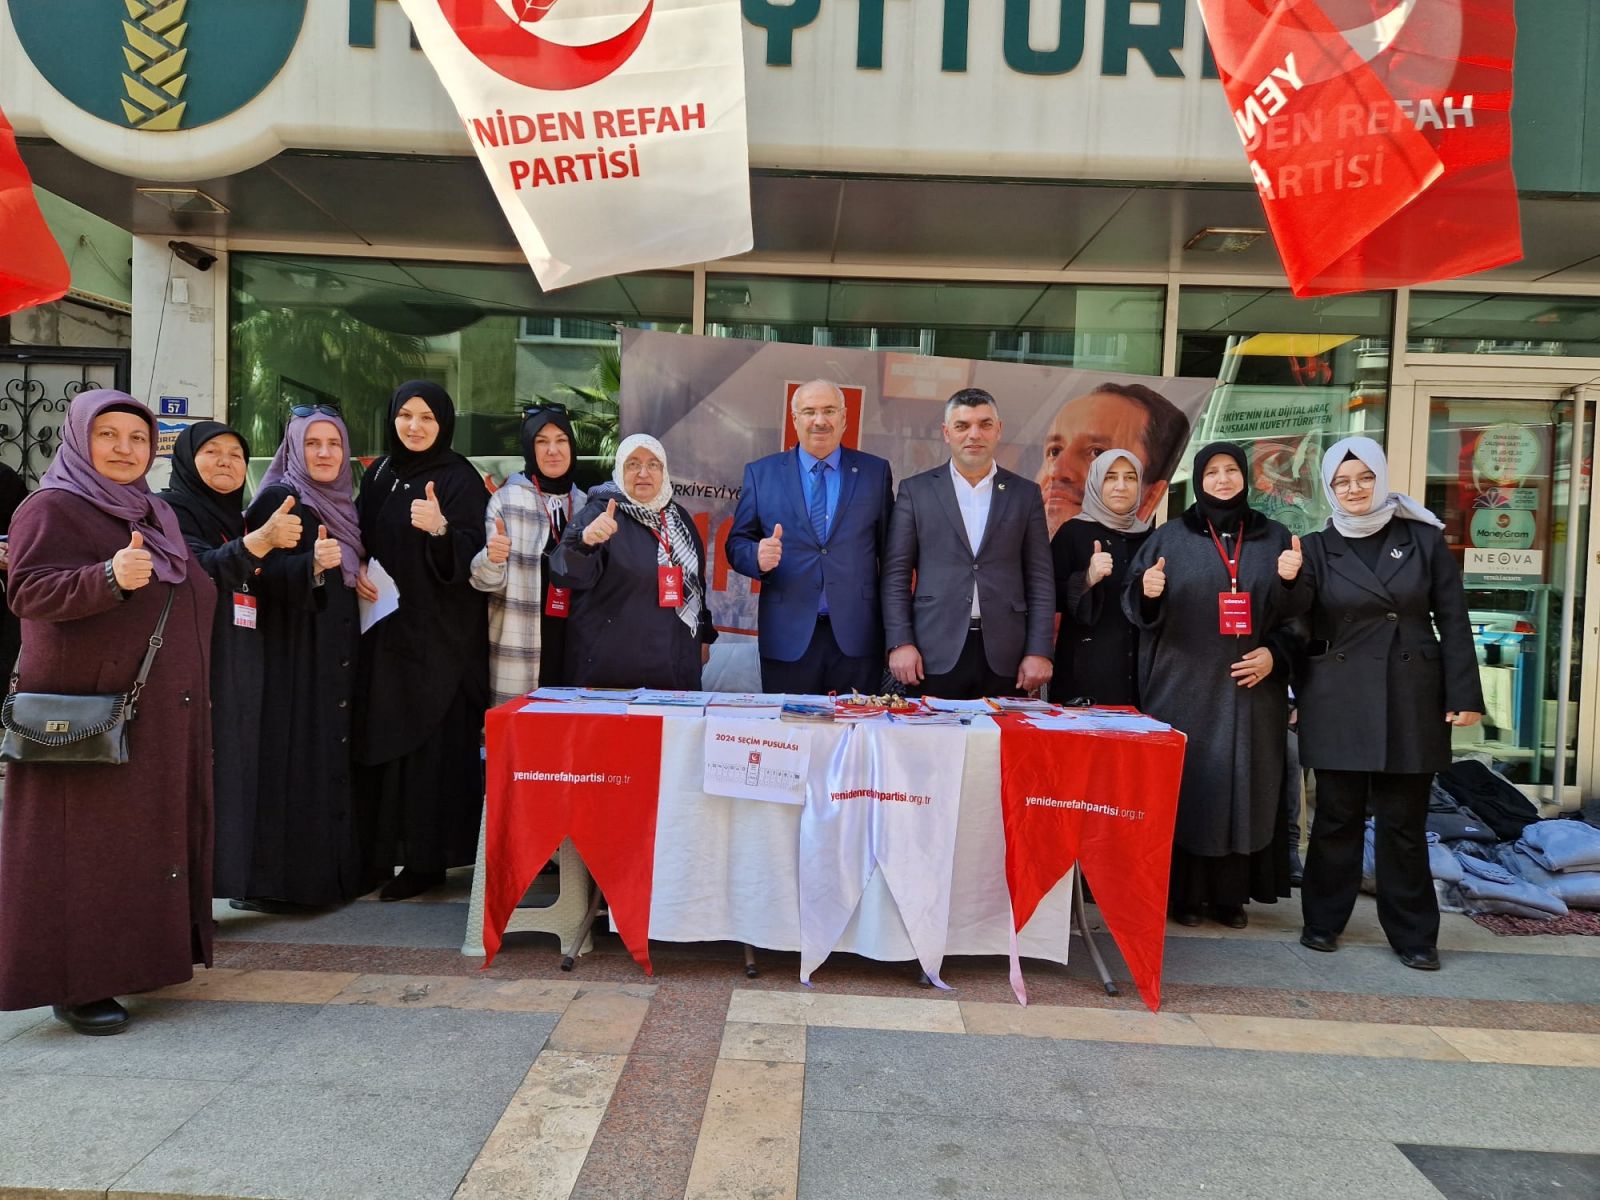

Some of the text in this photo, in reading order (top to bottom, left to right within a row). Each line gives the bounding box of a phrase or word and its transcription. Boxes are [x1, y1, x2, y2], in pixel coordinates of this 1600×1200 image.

[1338, 94, 1474, 139] REFAH
[470, 103, 706, 148] NİDEN REFAH
[509, 143, 641, 191] PARTİSİ
[167, 403, 181, 413] 57
[1263, 406, 1277, 418] İLK
[1308, 403, 1330, 414] ARAÇ
[1259, 419, 1291, 430] KUVEYT
[1476, 529, 1529, 540] MoneyGram
[1474, 552, 1532, 565] NEOVA
[715, 733, 799, 752] 2024 SEÇİM PUSULASI
[513, 770, 632, 786] yenidenrefahpartisi.org.tr
[1025, 796, 1146, 820] yenidenrefahpartisi.org.tr
